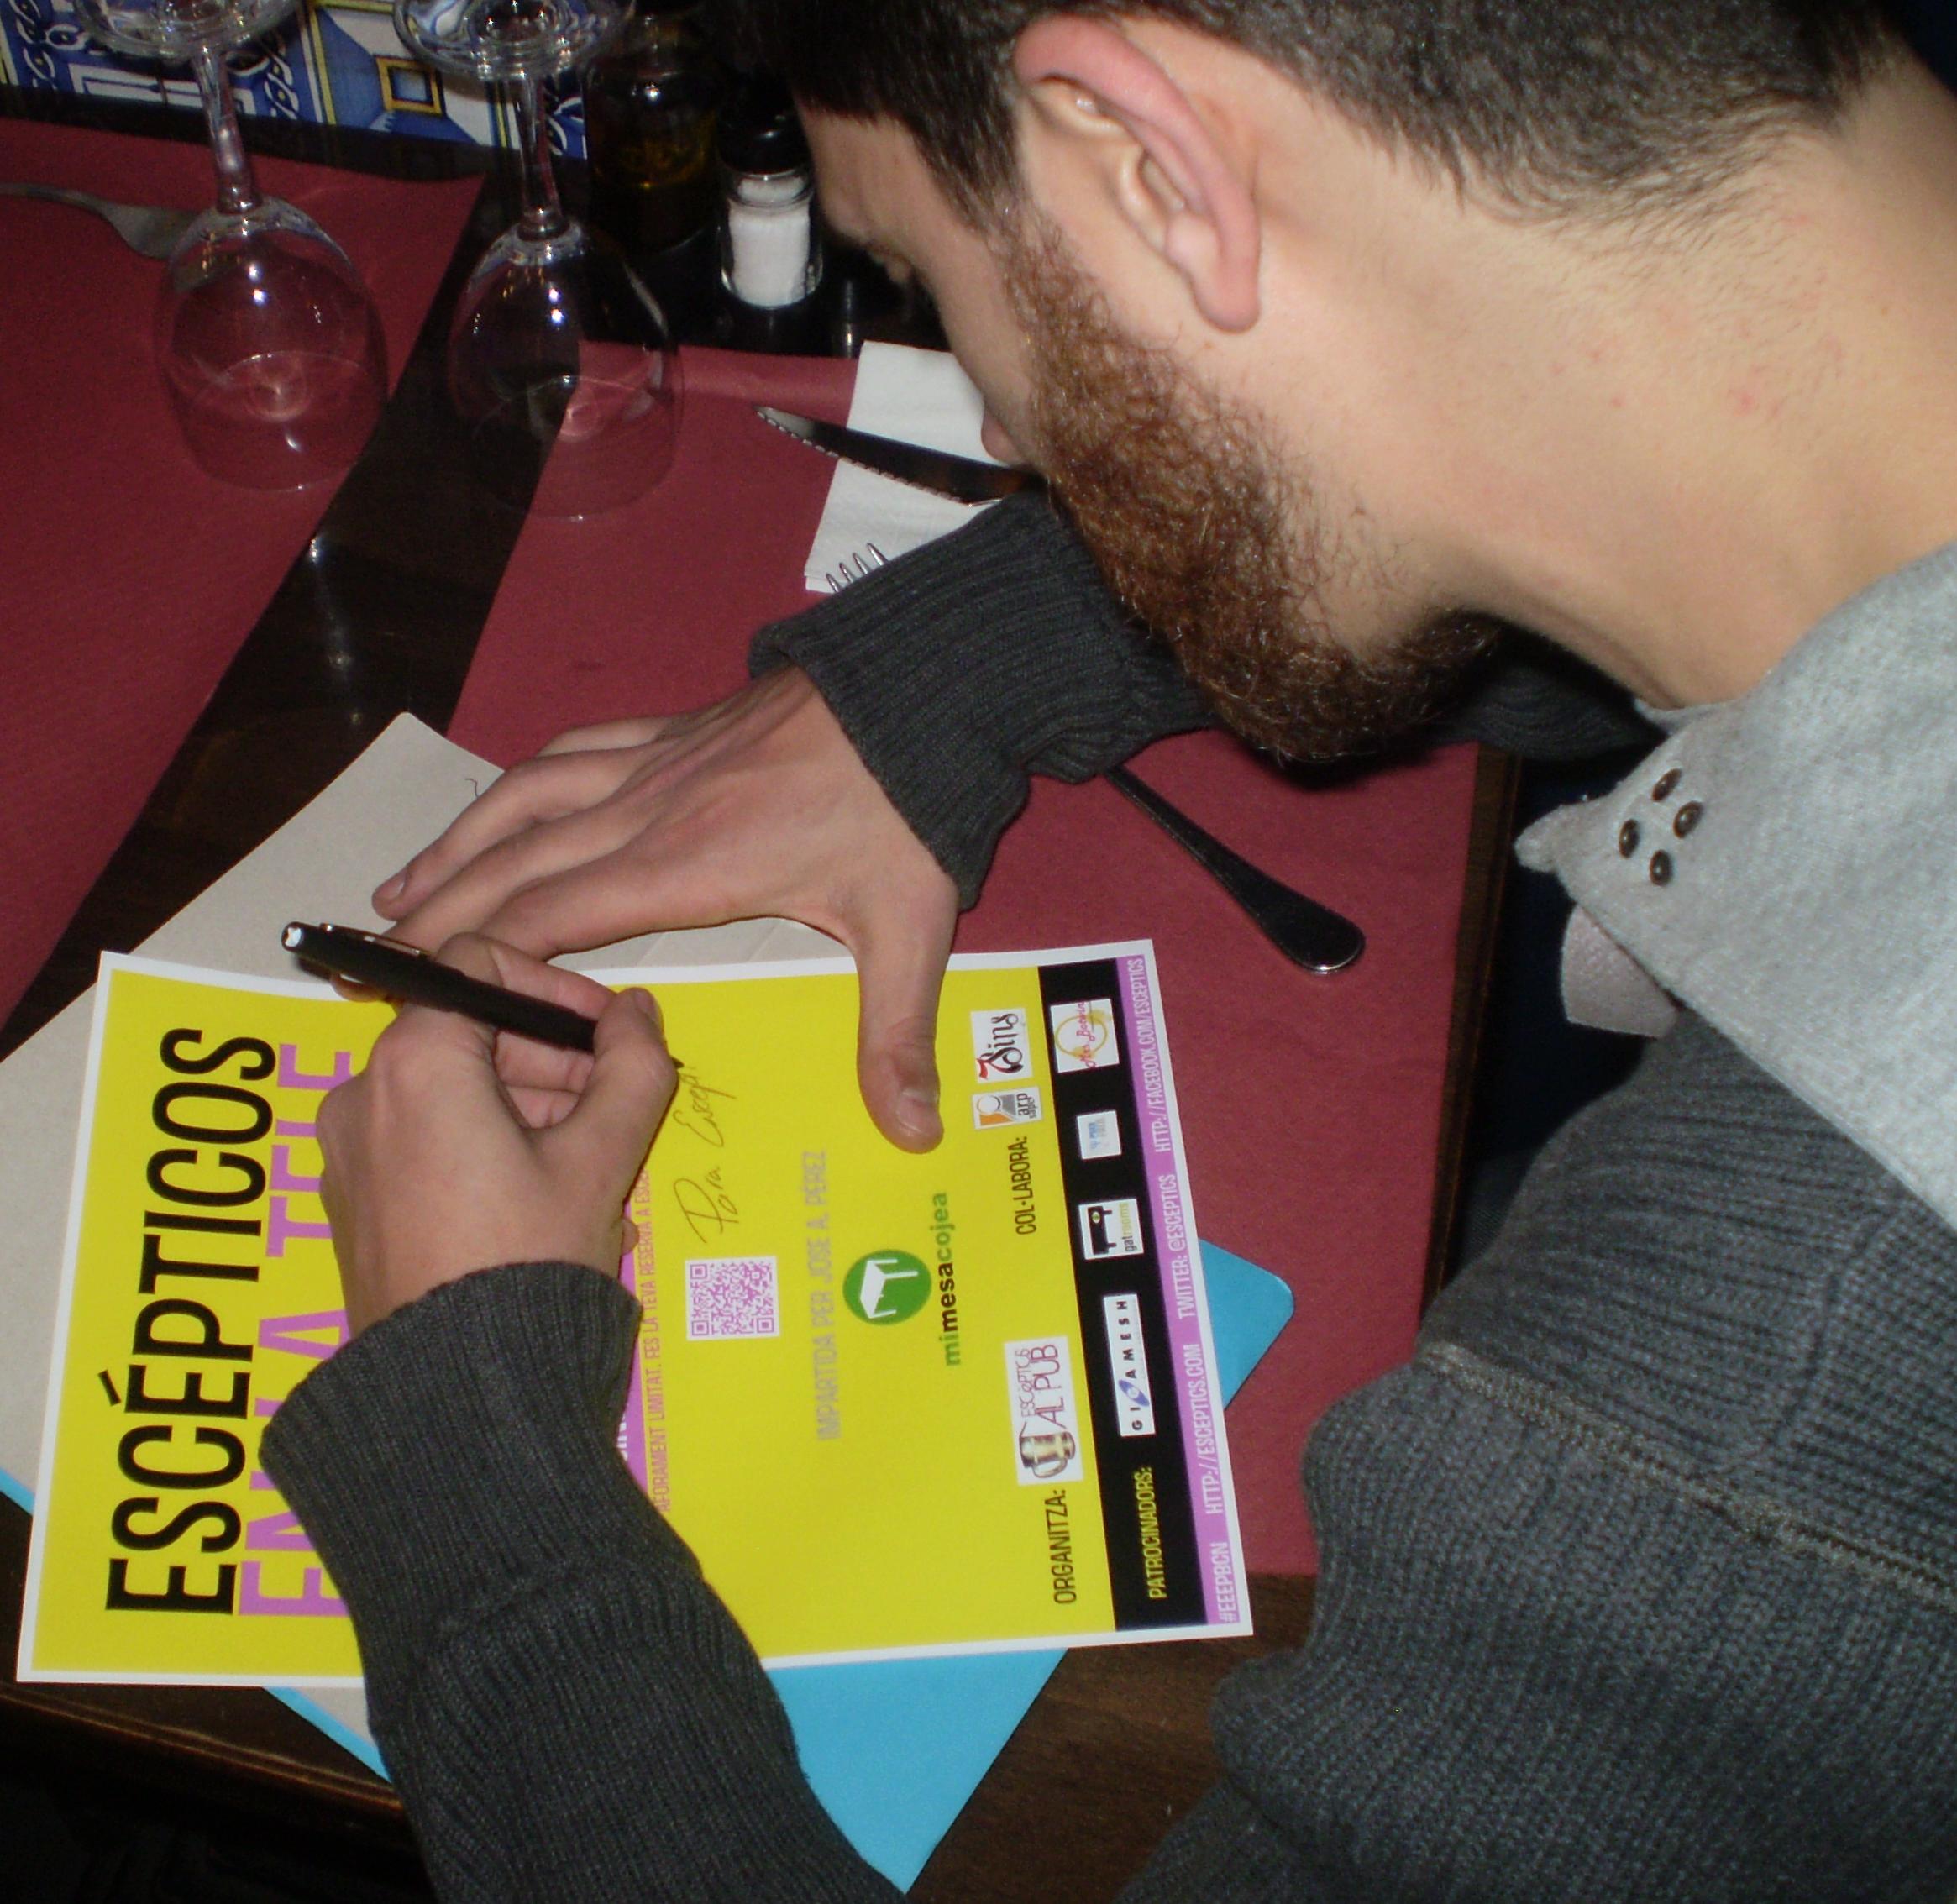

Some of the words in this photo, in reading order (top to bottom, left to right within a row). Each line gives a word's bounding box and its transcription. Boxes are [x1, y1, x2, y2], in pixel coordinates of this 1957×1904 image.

[800, 1150, 826, 1205] PÉREZ
[97, 1027, 275, 1616] ESCÉPTICOS
[809, 1290, 835, 1326] PER
[930, 1193, 962, 1366] mimesacojea
[810, 1332, 842, 1440] IMPARTIDA
[1030, 1344, 1062, 1391] PUB
[1045, 1490, 1077, 1604] ORGANITZA:
[1134, 1466, 1168, 1599] PATROCINADORS:
